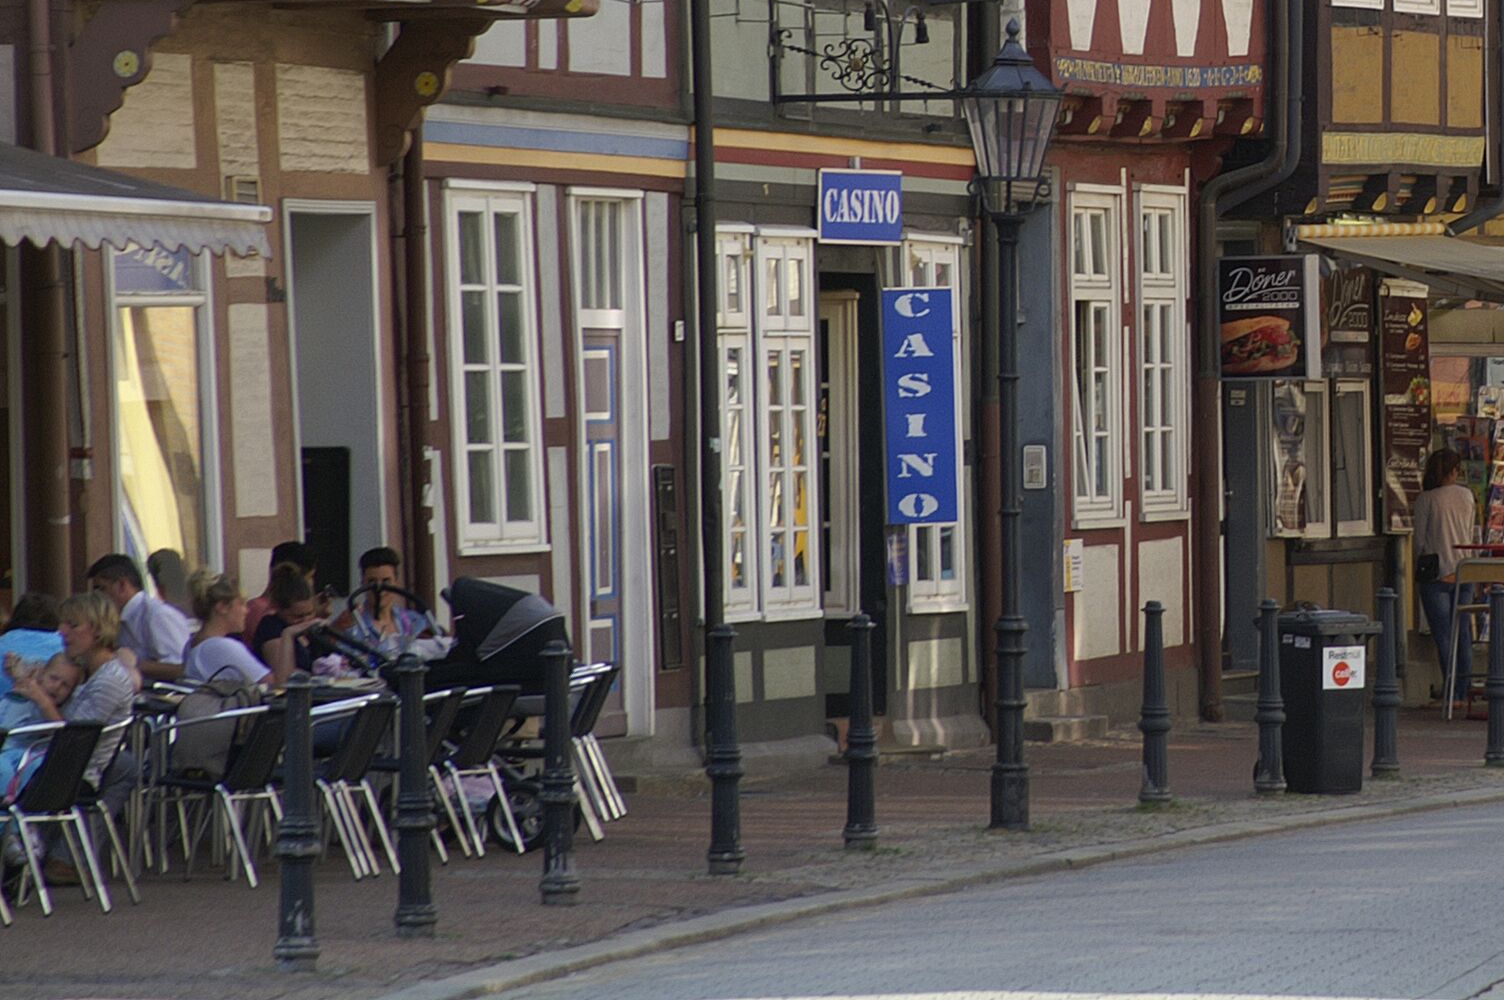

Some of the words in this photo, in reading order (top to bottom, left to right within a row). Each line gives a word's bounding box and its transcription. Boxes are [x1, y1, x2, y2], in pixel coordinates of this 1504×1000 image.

[824, 187, 900, 225] CASINO
[1222, 267, 1297, 302] Döner
[1262, 290, 1298, 302] 2000
[894, 293, 939, 518] CASINO
